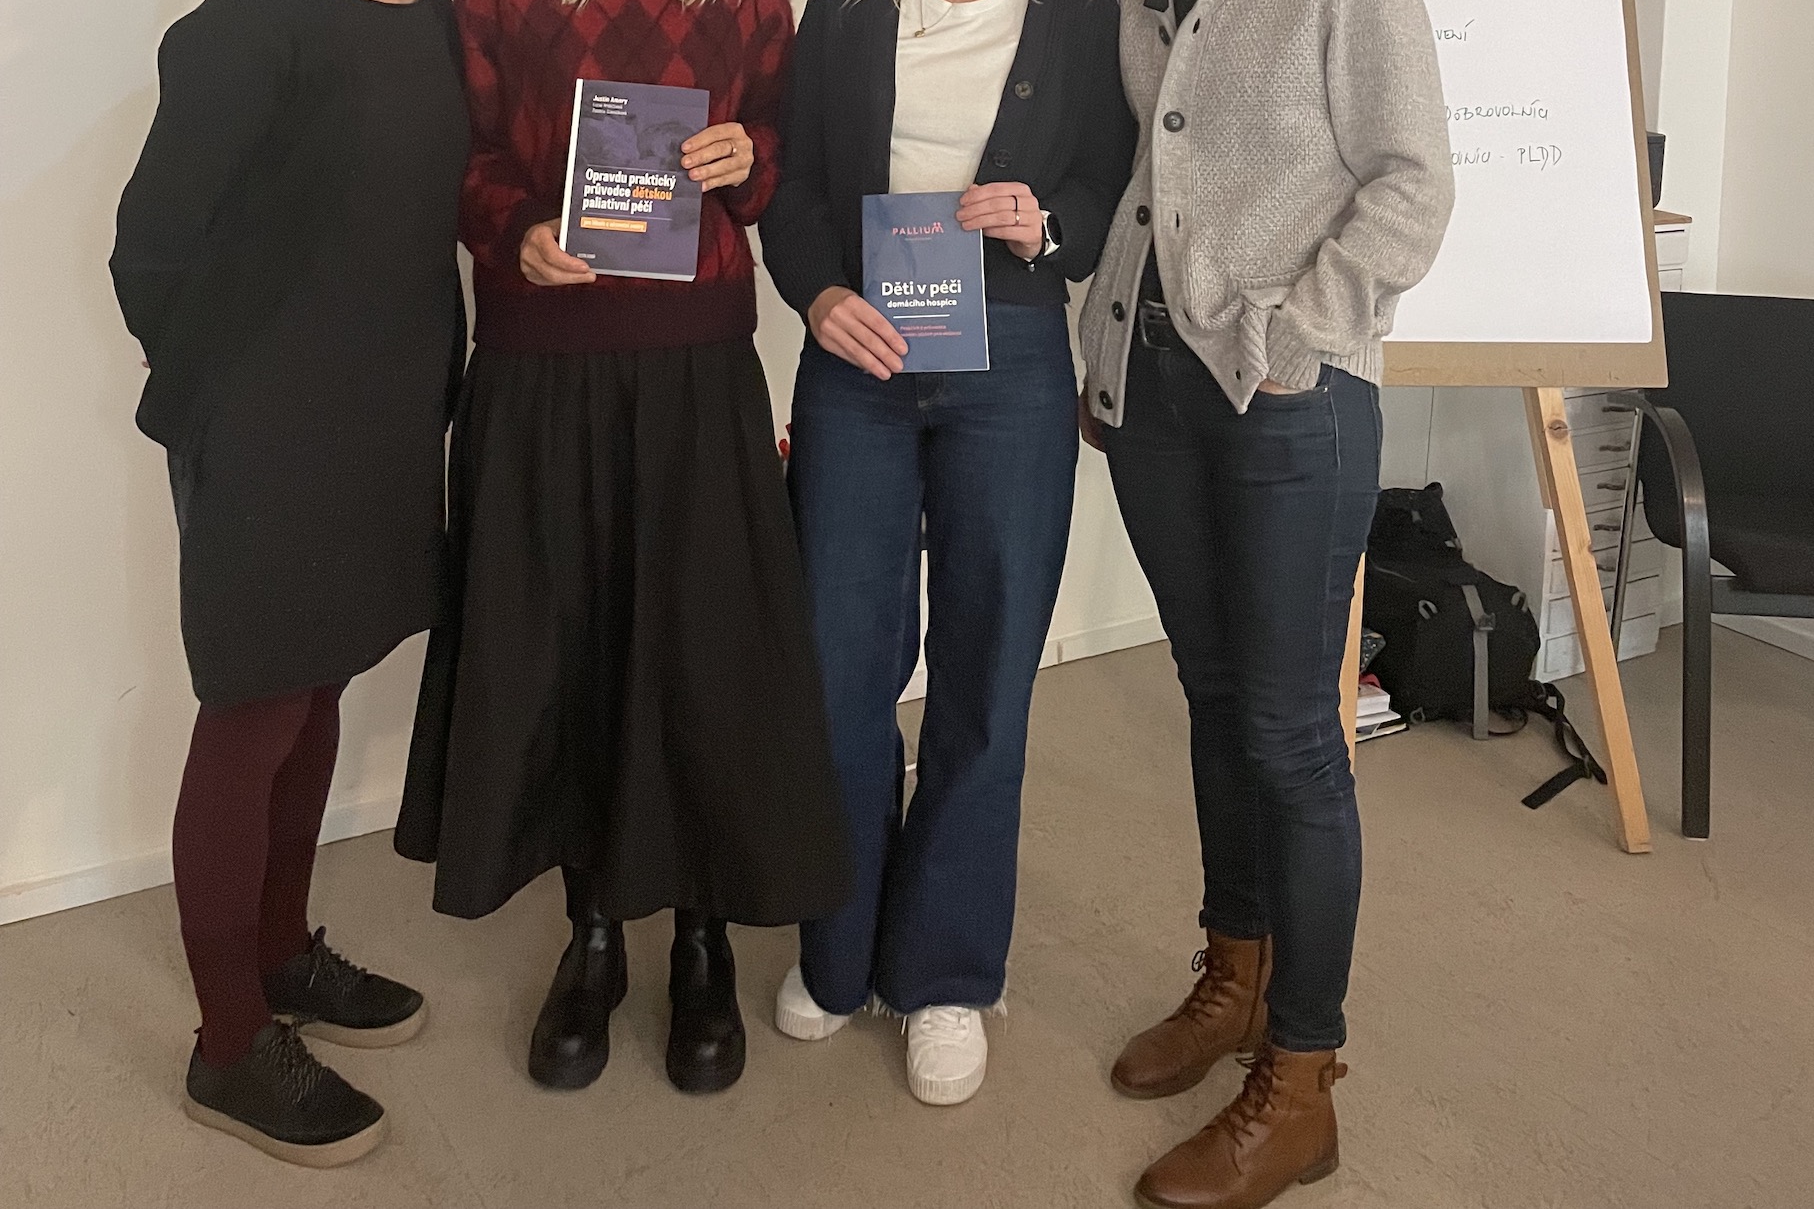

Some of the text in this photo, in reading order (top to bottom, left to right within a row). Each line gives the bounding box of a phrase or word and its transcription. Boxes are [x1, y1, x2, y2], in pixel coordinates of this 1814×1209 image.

[585, 168, 677, 190] Opravdu praktický
[583, 183, 673, 201] průvodce dětskou
[582, 196, 630, 211] paliativní
[881, 279, 962, 298] Děti v péči
